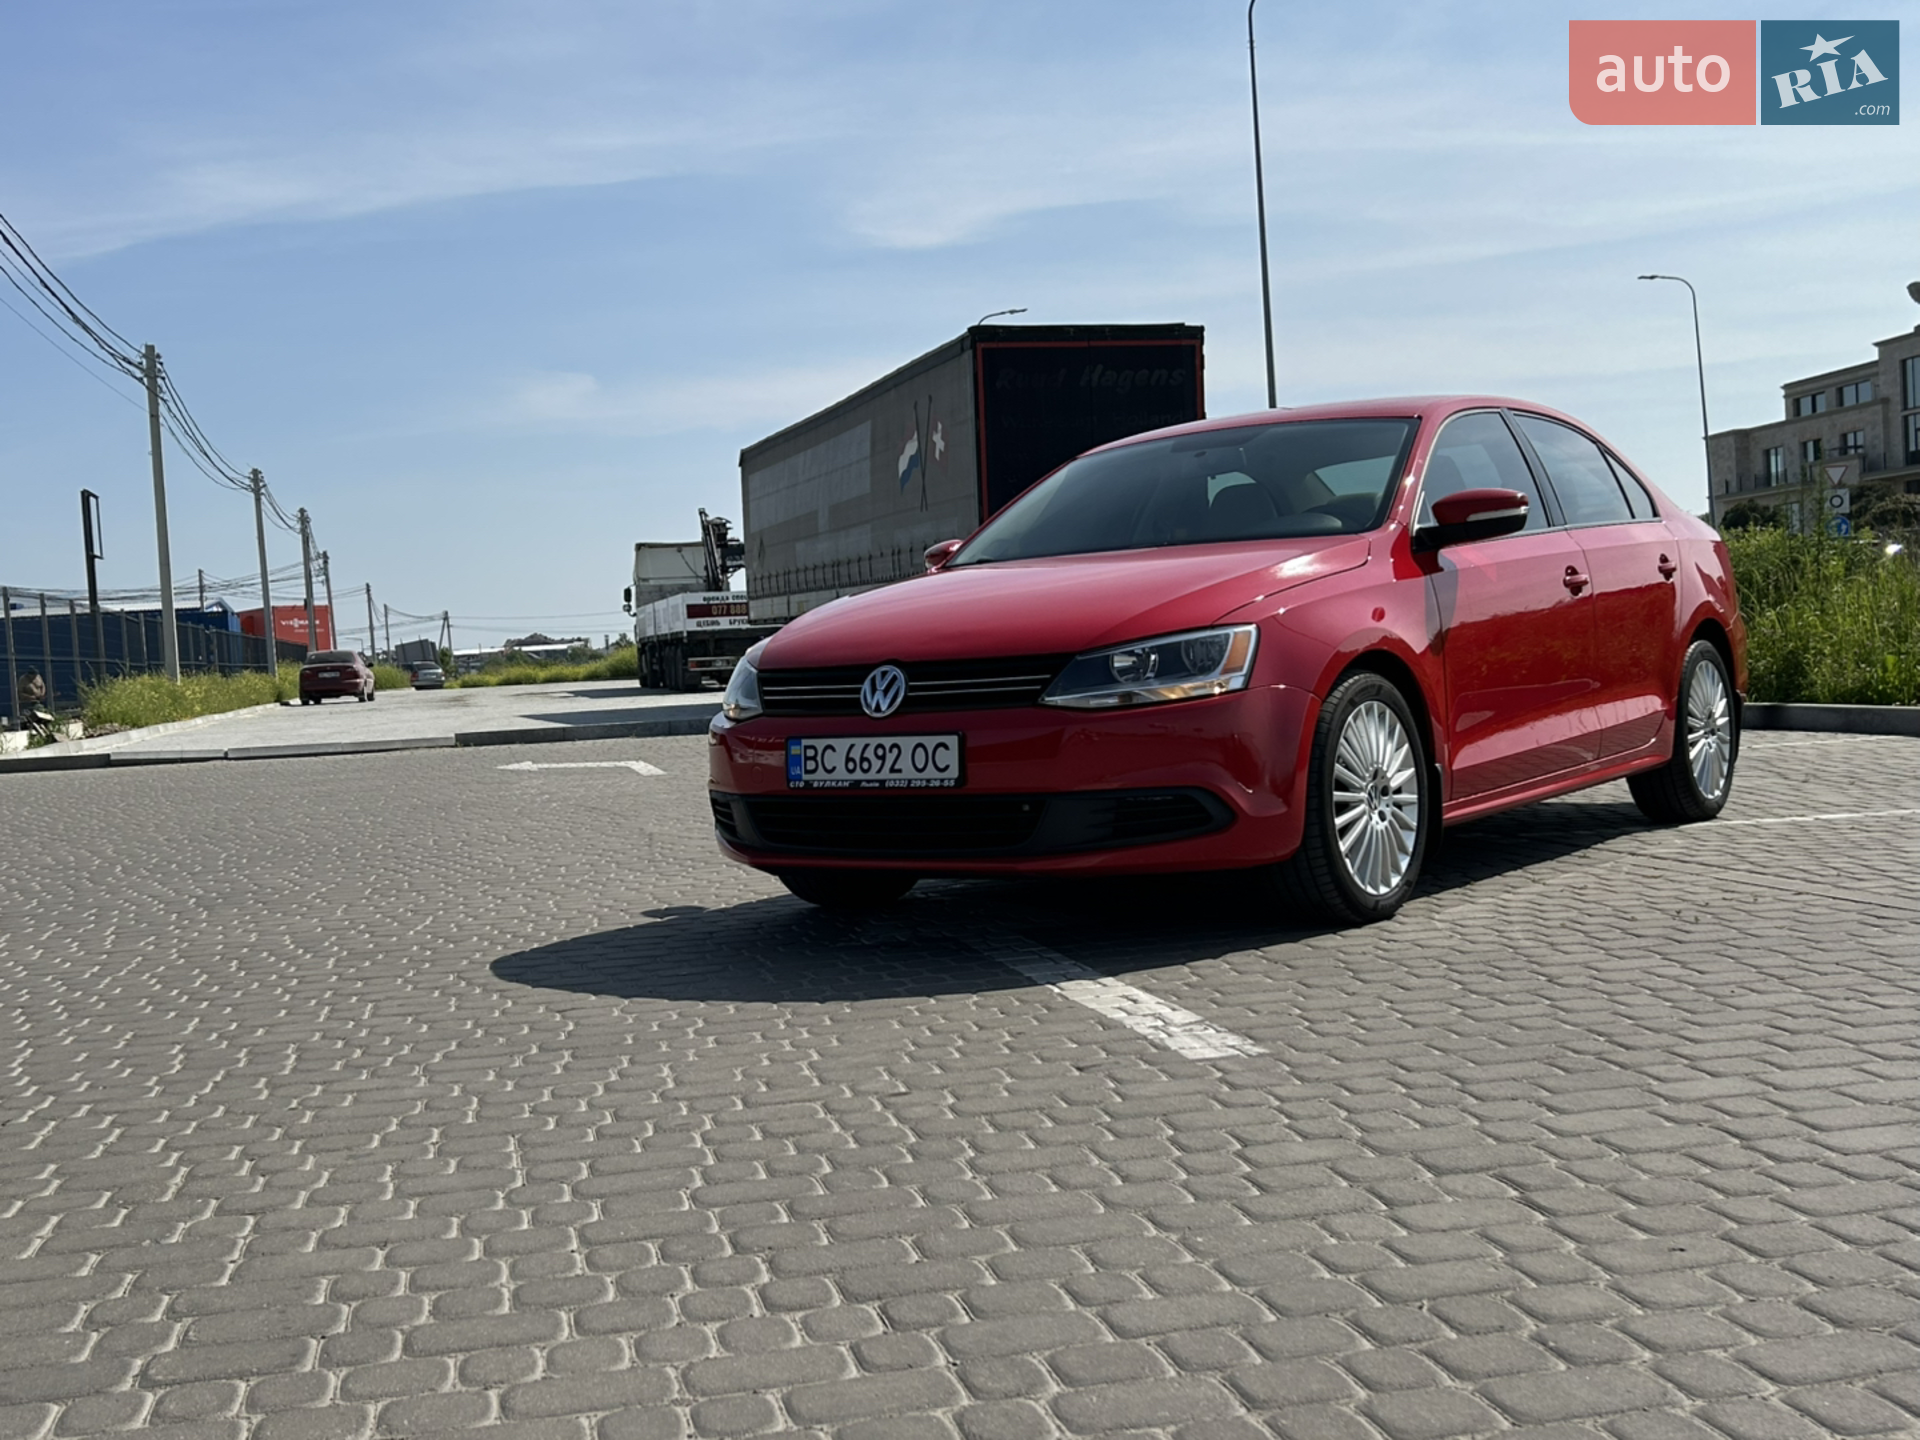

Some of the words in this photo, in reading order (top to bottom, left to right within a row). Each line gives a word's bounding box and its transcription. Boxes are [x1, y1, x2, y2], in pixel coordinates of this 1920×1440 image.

[1078, 363, 1187, 395] Hagens
[790, 766, 802, 776] UA
[803, 743, 838, 775] BC
[844, 743, 903, 775] 6692
[910, 741, 951, 774] OC
